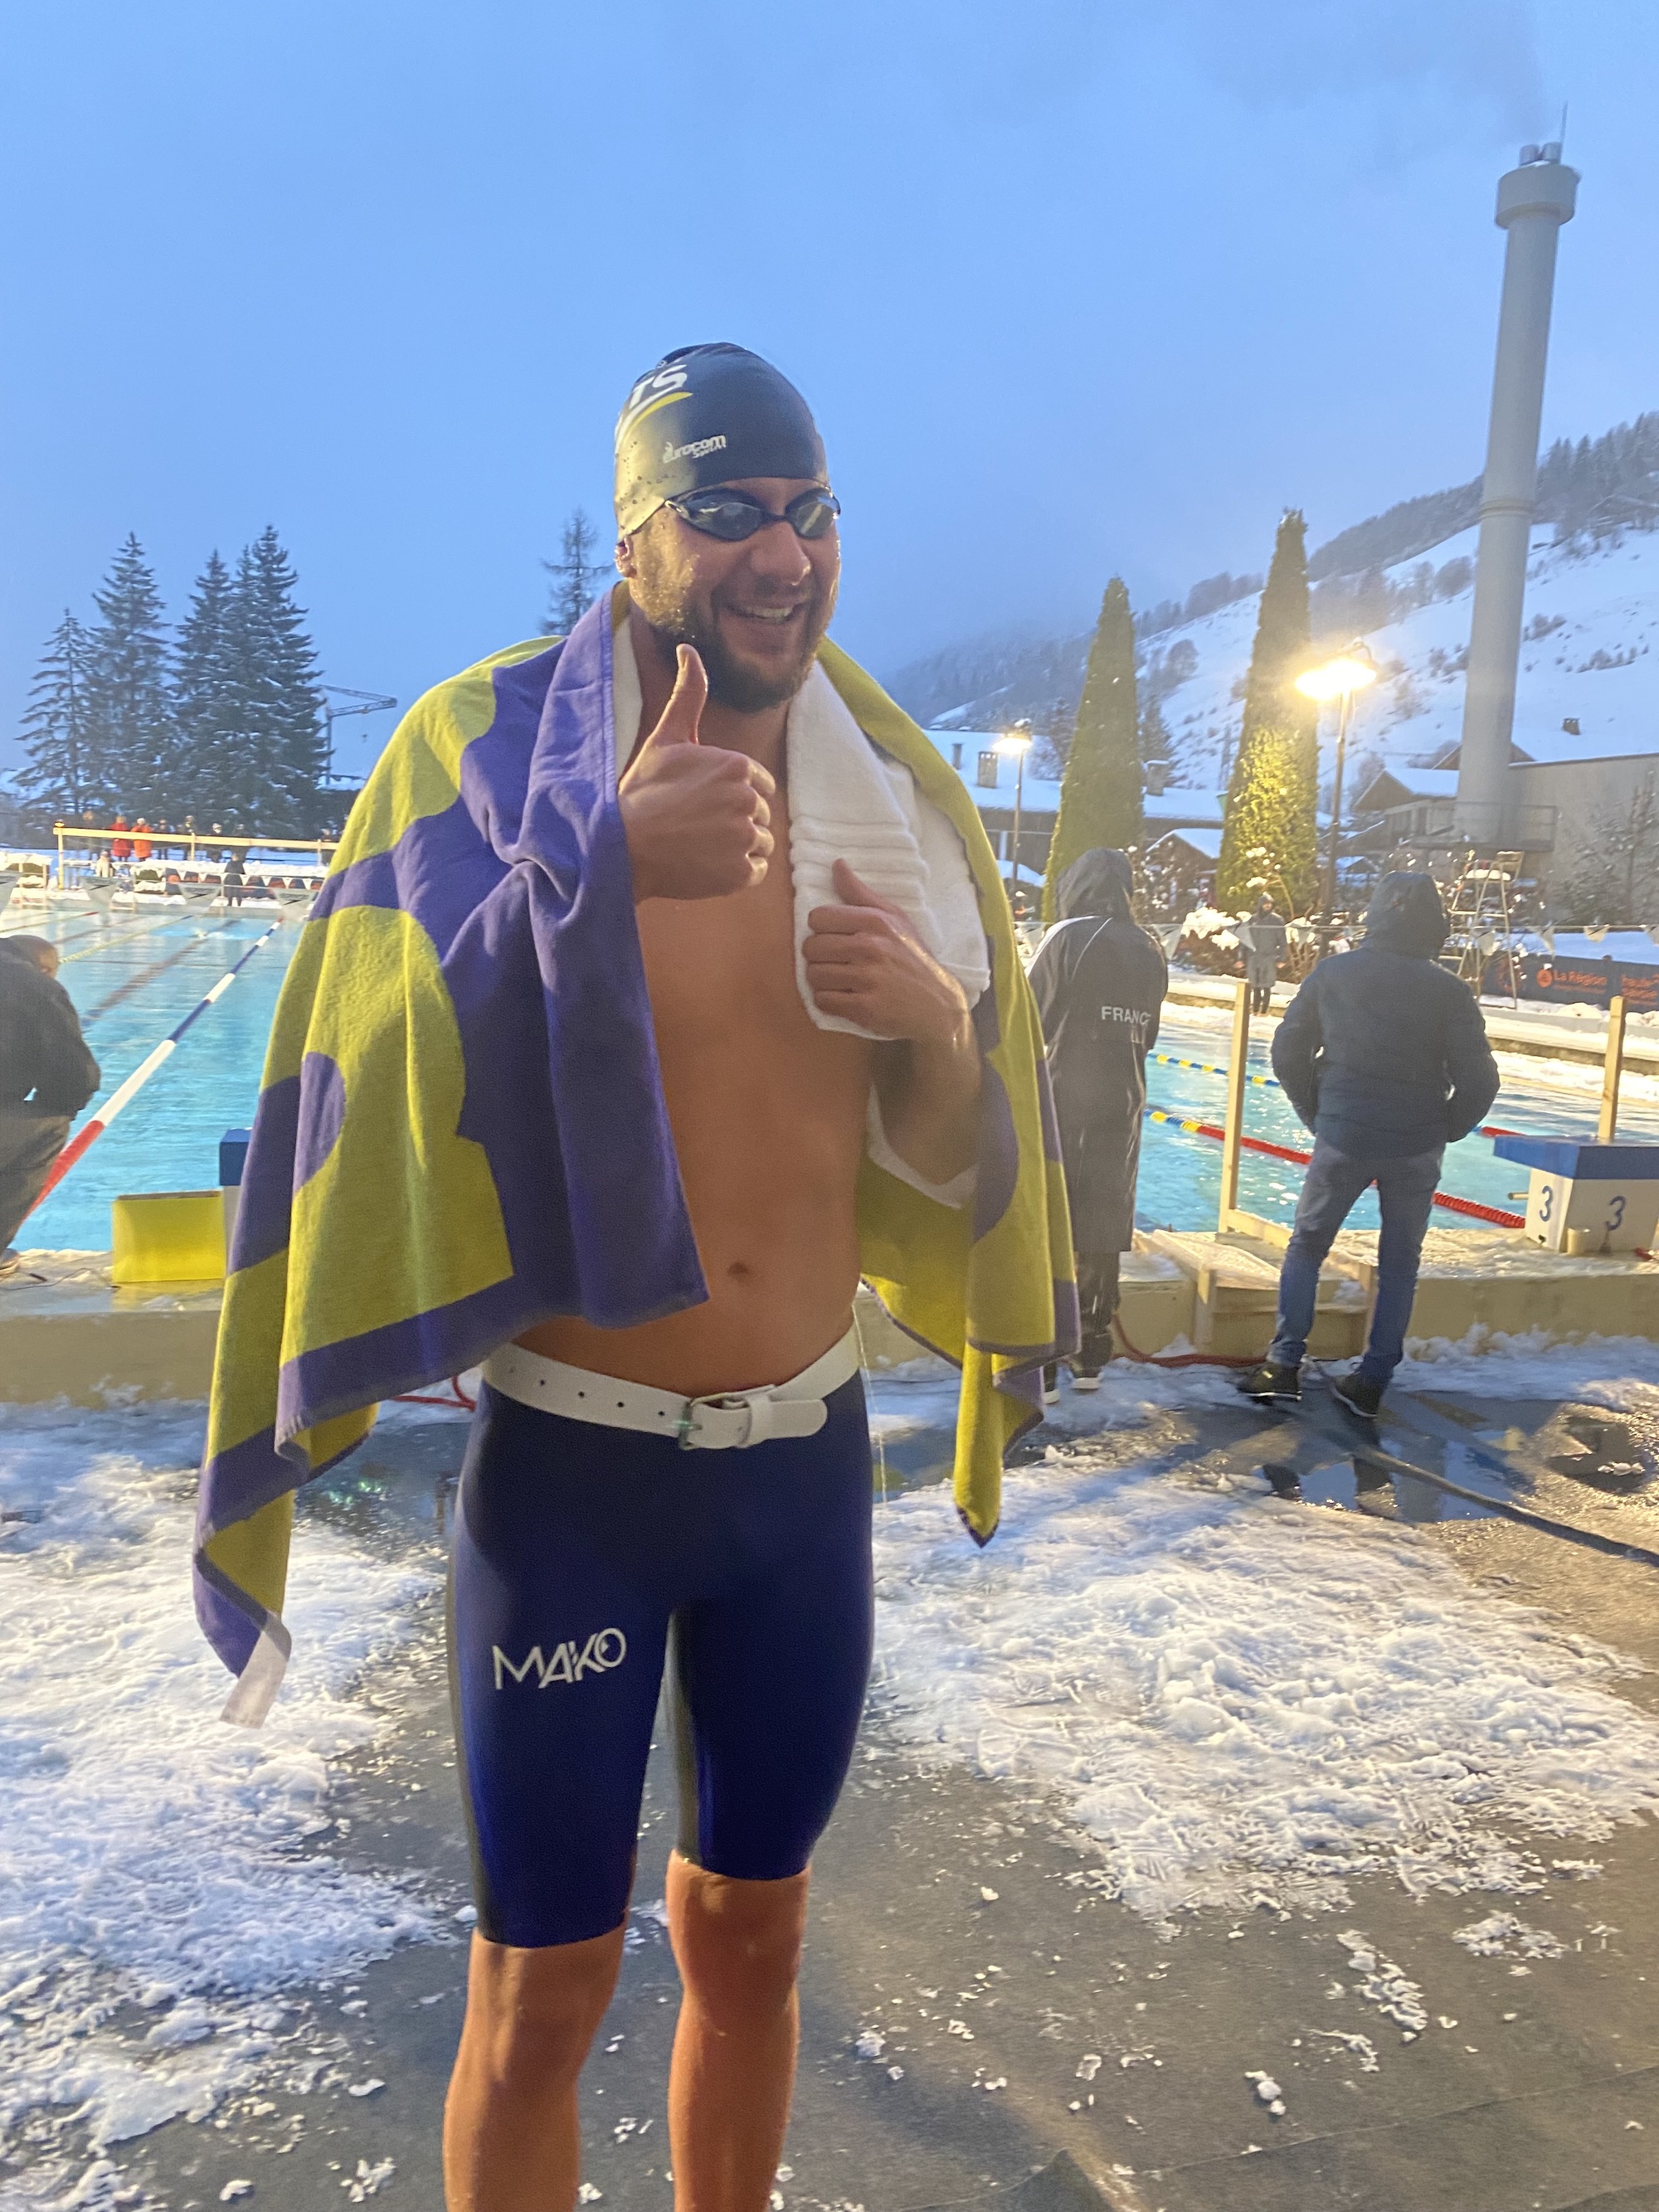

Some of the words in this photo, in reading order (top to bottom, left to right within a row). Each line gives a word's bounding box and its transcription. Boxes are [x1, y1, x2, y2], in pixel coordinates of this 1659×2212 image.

[1554, 970, 1567, 982] La
[1101, 1005, 1152, 1026] FRANC
[1539, 1185, 1554, 1223] 3
[1604, 1195, 1627, 1231] 3
[492, 1627, 627, 1690] MAKO
